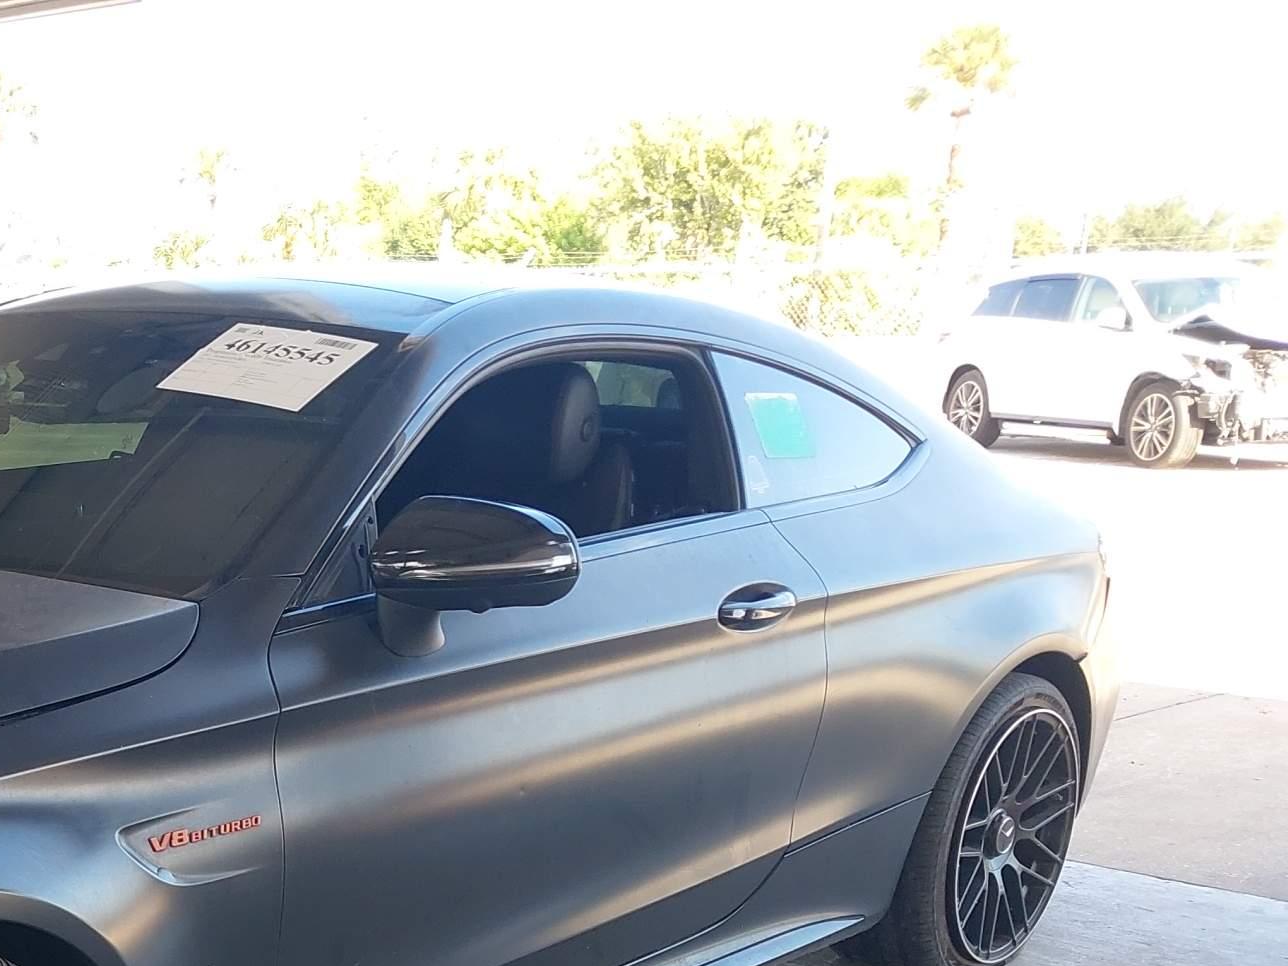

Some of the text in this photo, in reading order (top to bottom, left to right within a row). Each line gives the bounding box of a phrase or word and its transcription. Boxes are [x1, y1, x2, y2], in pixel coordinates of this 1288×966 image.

[224, 339, 340, 366] 46145545
[148, 815, 262, 853] V8 BITURBO
